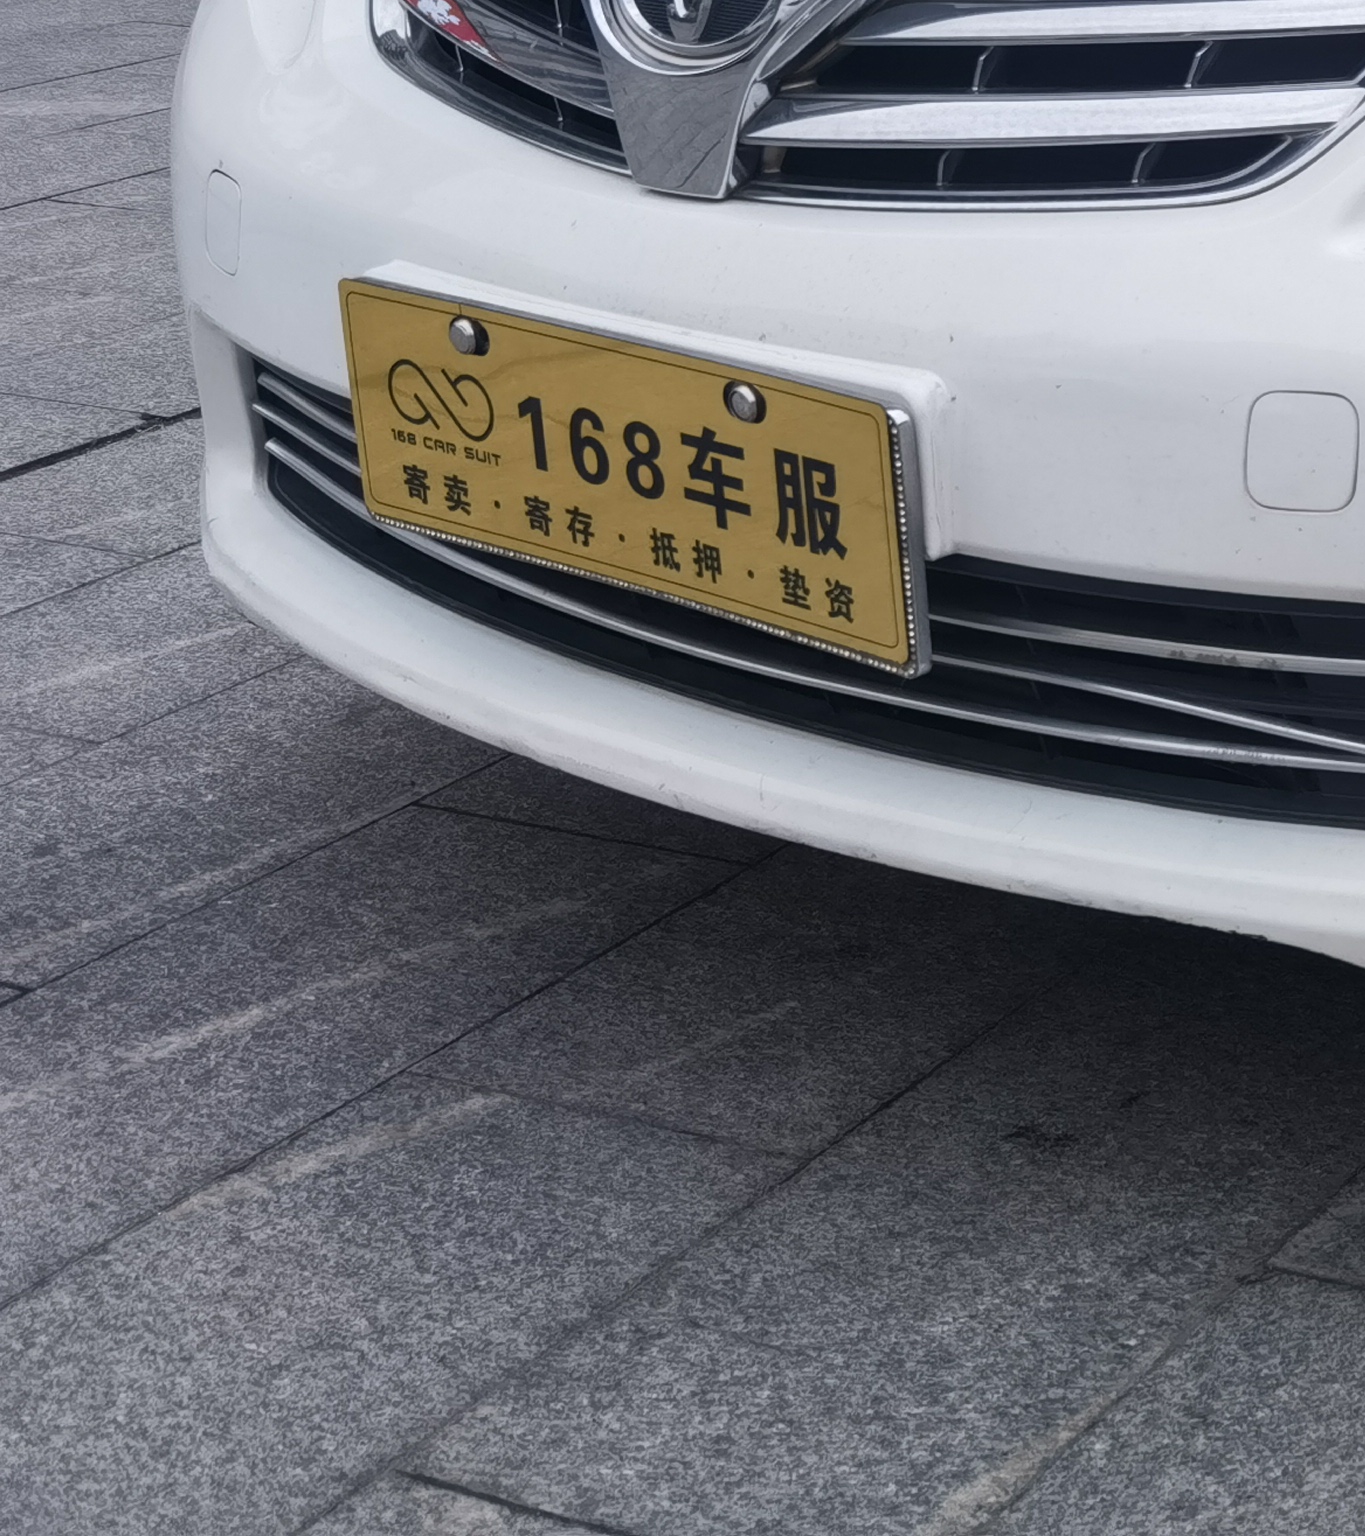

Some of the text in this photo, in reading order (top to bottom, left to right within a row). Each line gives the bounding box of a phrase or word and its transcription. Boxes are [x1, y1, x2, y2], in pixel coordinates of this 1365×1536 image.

[391, 428, 502, 467] 168 CAR SUIT
[517, 394, 848, 561] 168车服
